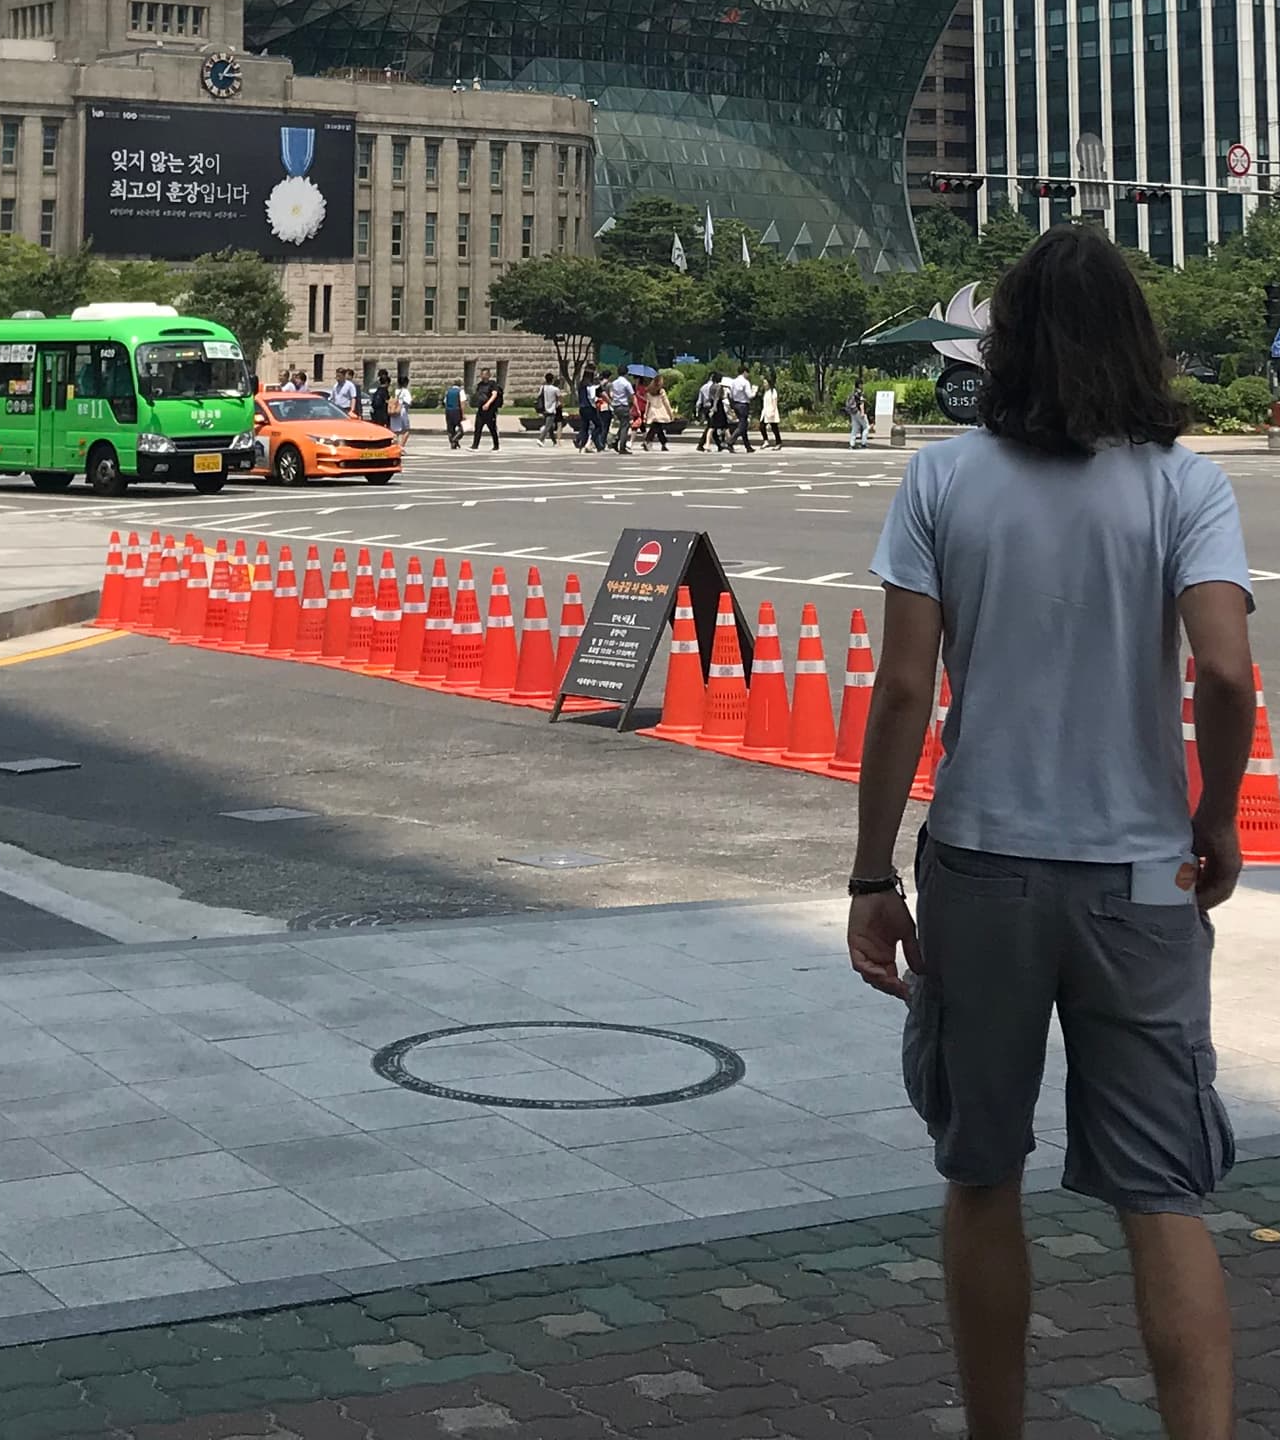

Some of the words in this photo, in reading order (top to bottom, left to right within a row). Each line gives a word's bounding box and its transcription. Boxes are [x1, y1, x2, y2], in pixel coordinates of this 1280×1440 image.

[111, 149, 145, 173] 잊지
[150, 151, 185, 174] 않는
[187, 153, 221, 175] 것이
[110, 179, 162, 202] 최고의
[165, 182, 250, 205] 훈장입니다
[91, 400, 104, 419] 11
